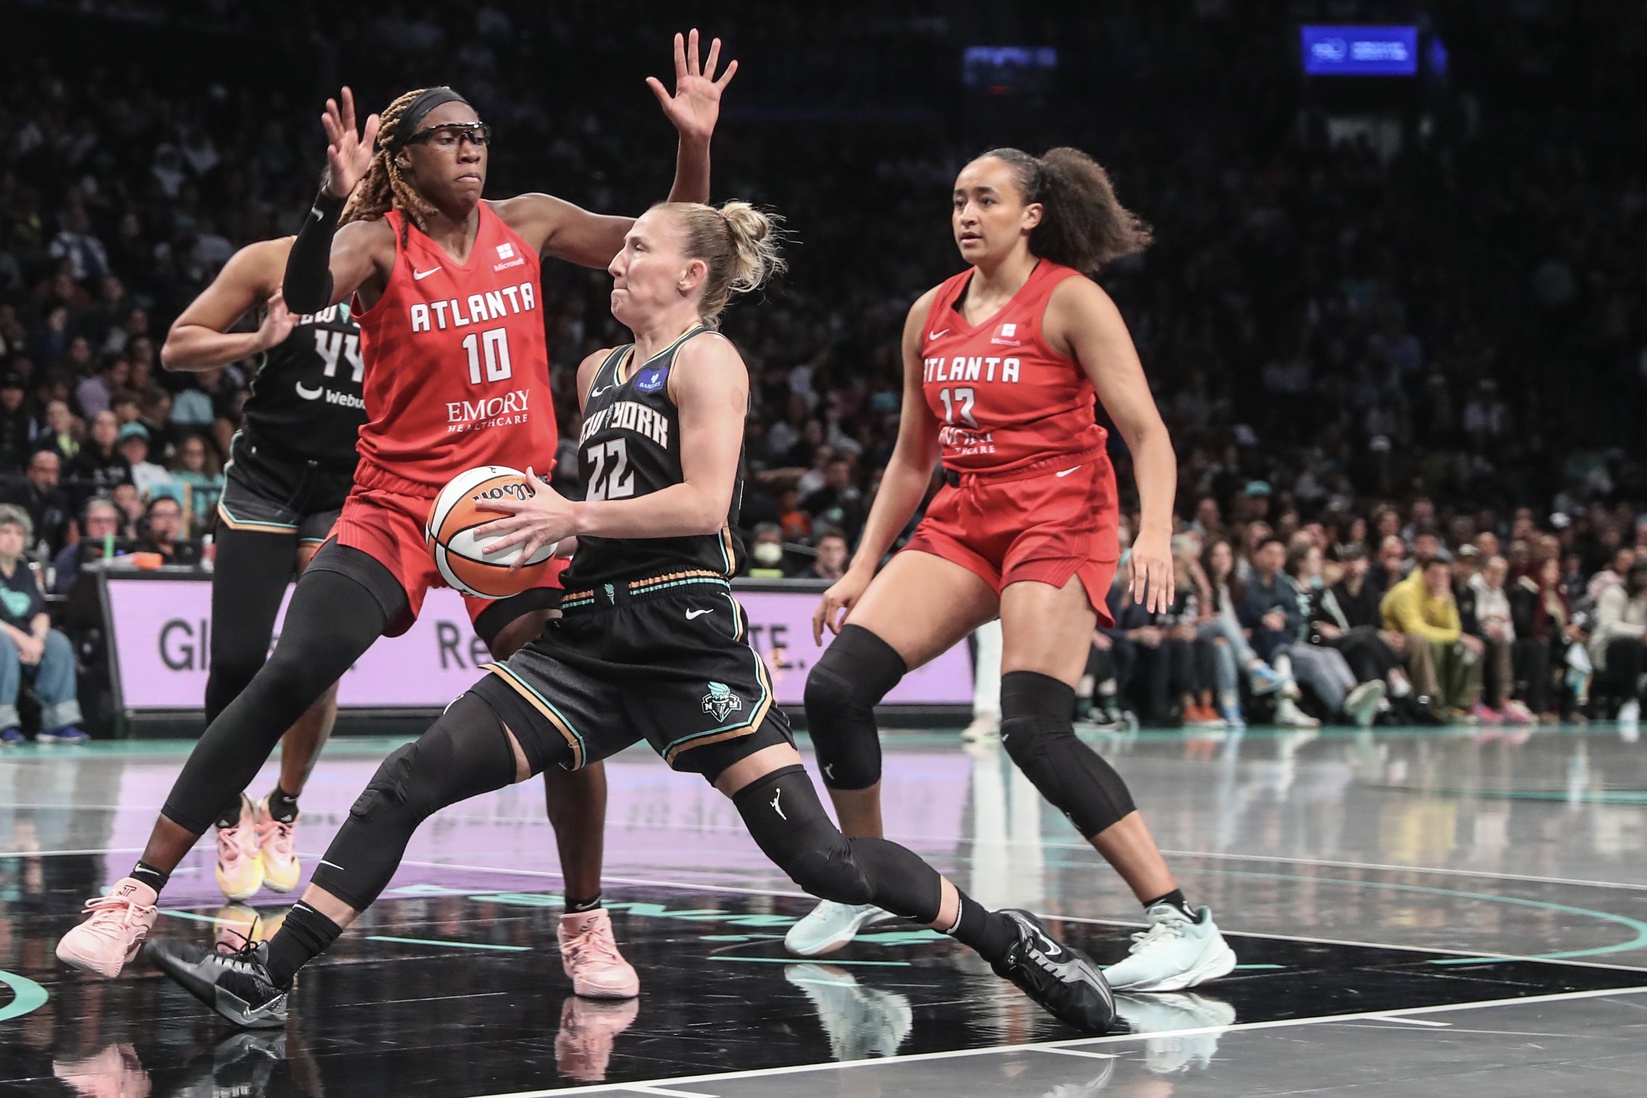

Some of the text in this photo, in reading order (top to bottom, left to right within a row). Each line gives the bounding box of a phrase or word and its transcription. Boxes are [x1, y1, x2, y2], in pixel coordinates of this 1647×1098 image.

[493, 257, 525, 272] Microsoft
[294, 305, 338, 327] EW
[410, 282, 535, 333] ATLANTA
[314, 328, 364, 383] 44
[462, 327, 512, 385] 10
[326, 388, 367, 410] Webu
[446, 389, 529, 422] EMORY
[447, 414, 528, 433] HEALTHCARE
[577, 401, 669, 451] EW YORK
[585, 437, 635, 502] 22
